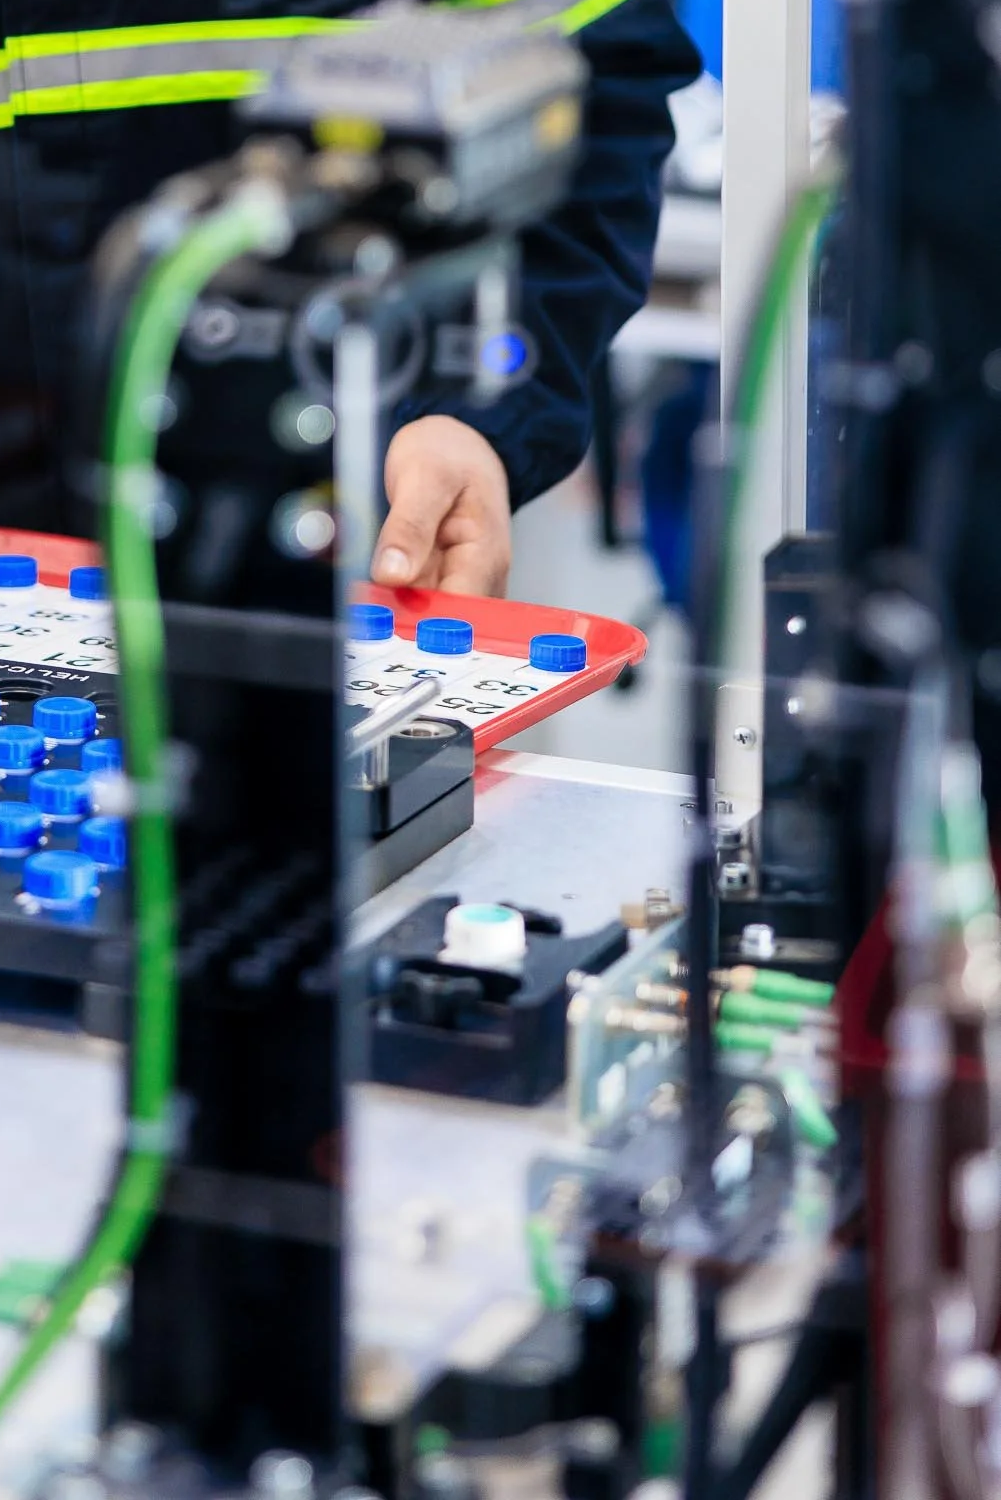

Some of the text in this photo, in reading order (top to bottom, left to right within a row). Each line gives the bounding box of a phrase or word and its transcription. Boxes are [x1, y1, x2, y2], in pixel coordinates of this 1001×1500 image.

[42, 651, 106, 668] 21
[383, 663, 447, 680] 34
[348, 679, 404, 697] 26
[473, 678, 539, 697] 33
[434, 696, 506, 716] 25
